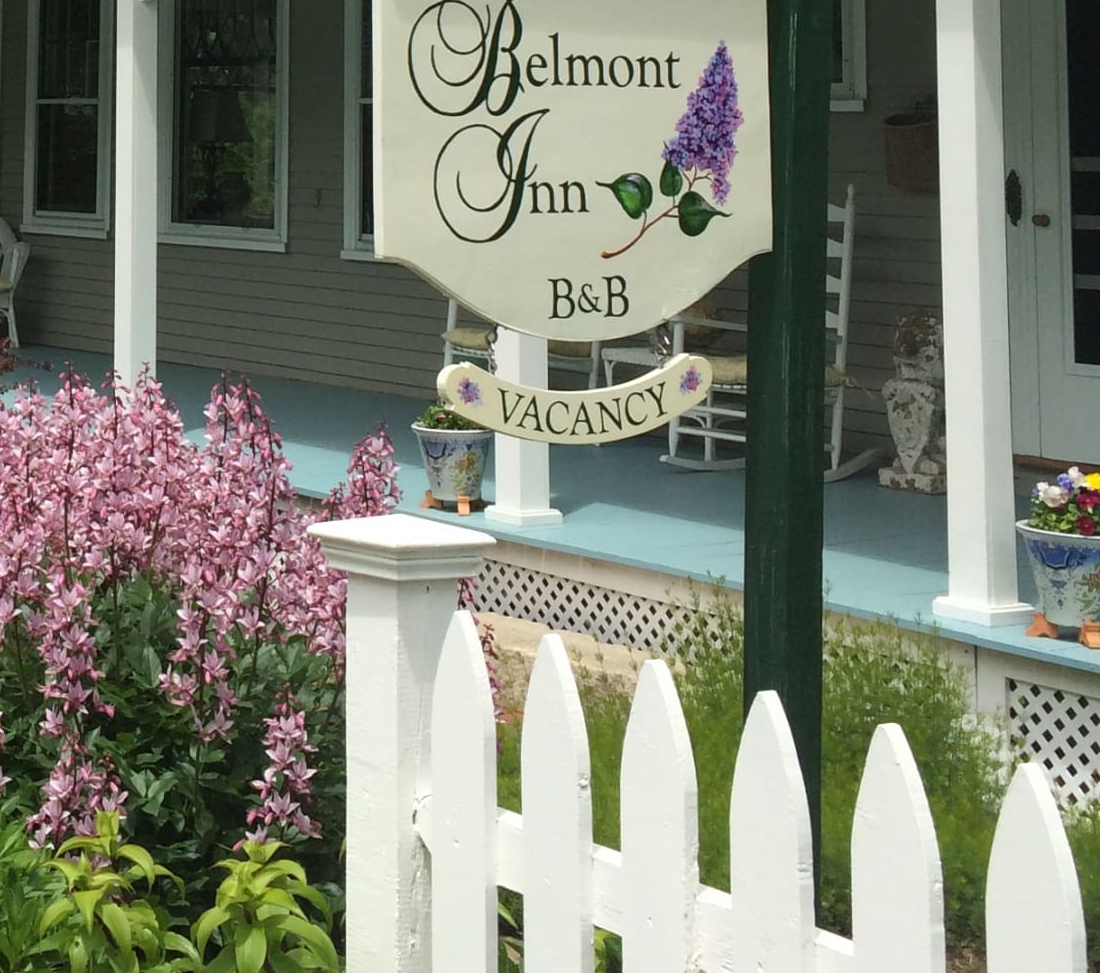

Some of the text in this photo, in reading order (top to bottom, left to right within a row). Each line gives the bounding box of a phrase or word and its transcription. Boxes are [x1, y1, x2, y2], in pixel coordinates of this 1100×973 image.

[434, 108, 590, 243] Inn
[548, 275, 630, 319] B&B
[497, 382, 668, 436] VACANCY
